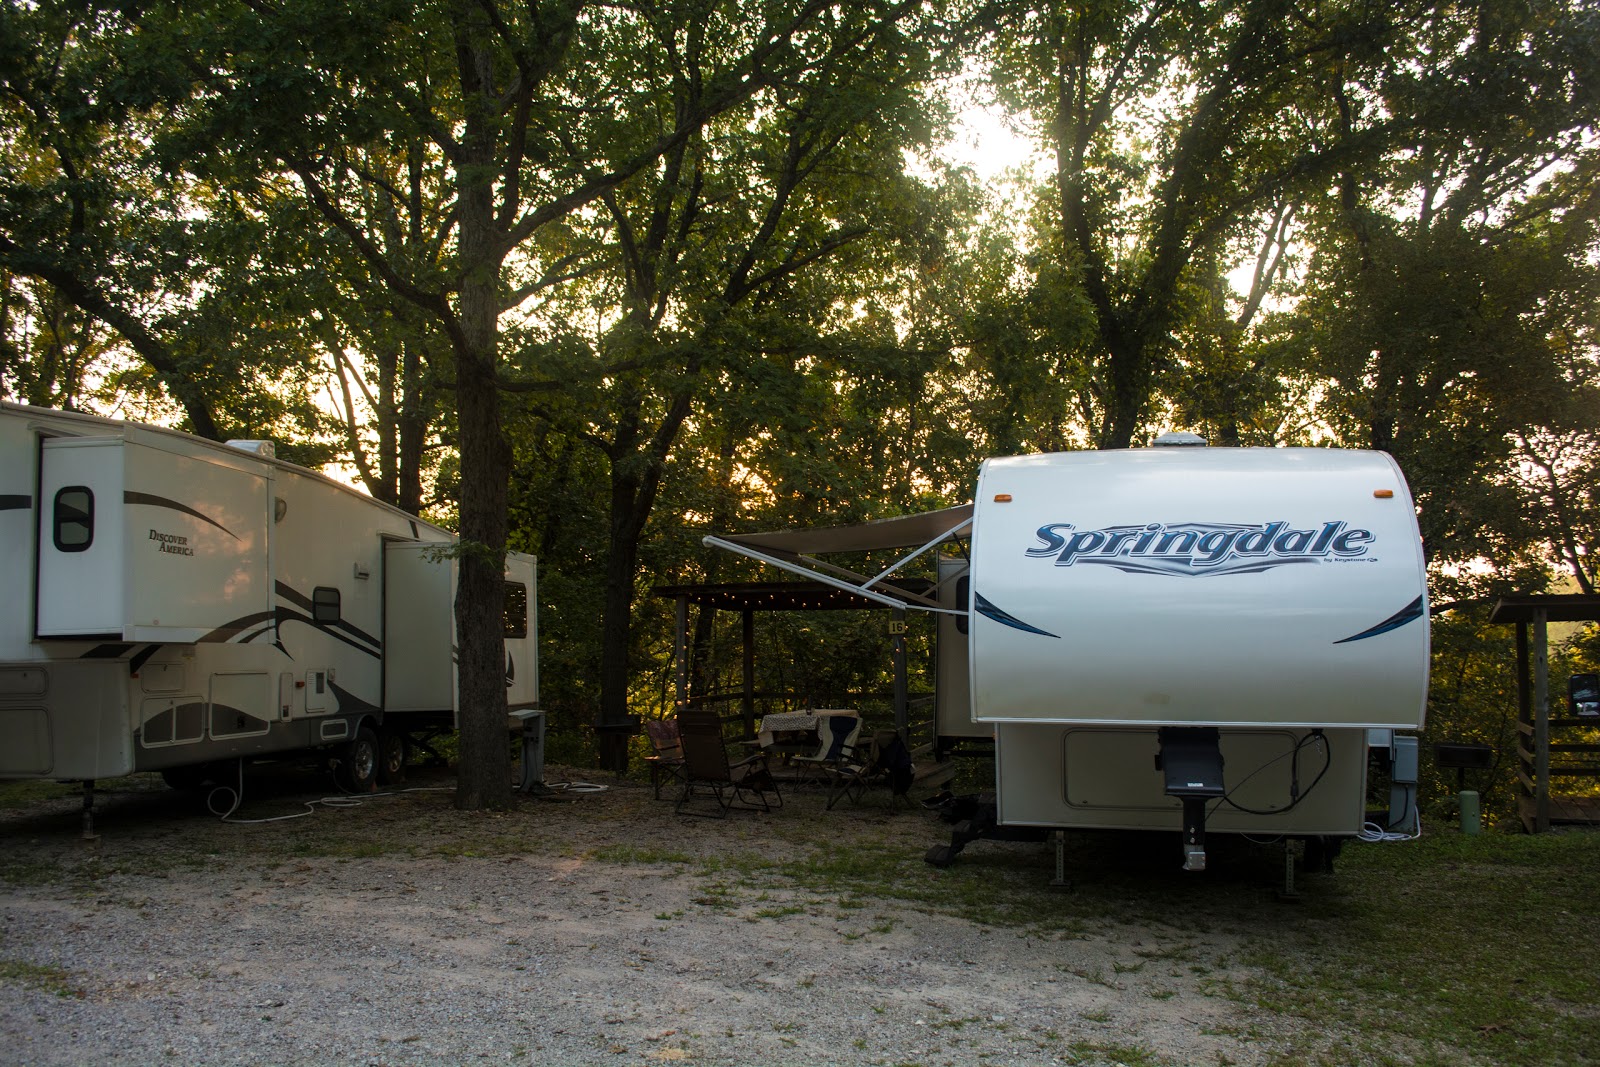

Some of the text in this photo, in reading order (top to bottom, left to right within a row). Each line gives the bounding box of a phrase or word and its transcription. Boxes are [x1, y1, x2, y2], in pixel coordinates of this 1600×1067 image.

[149, 529, 188, 546] DISCOVER
[1024, 521, 1376, 567] Springdale
[158, 542, 194, 557] AMERICA
[892, 622, 903, 632] 16
